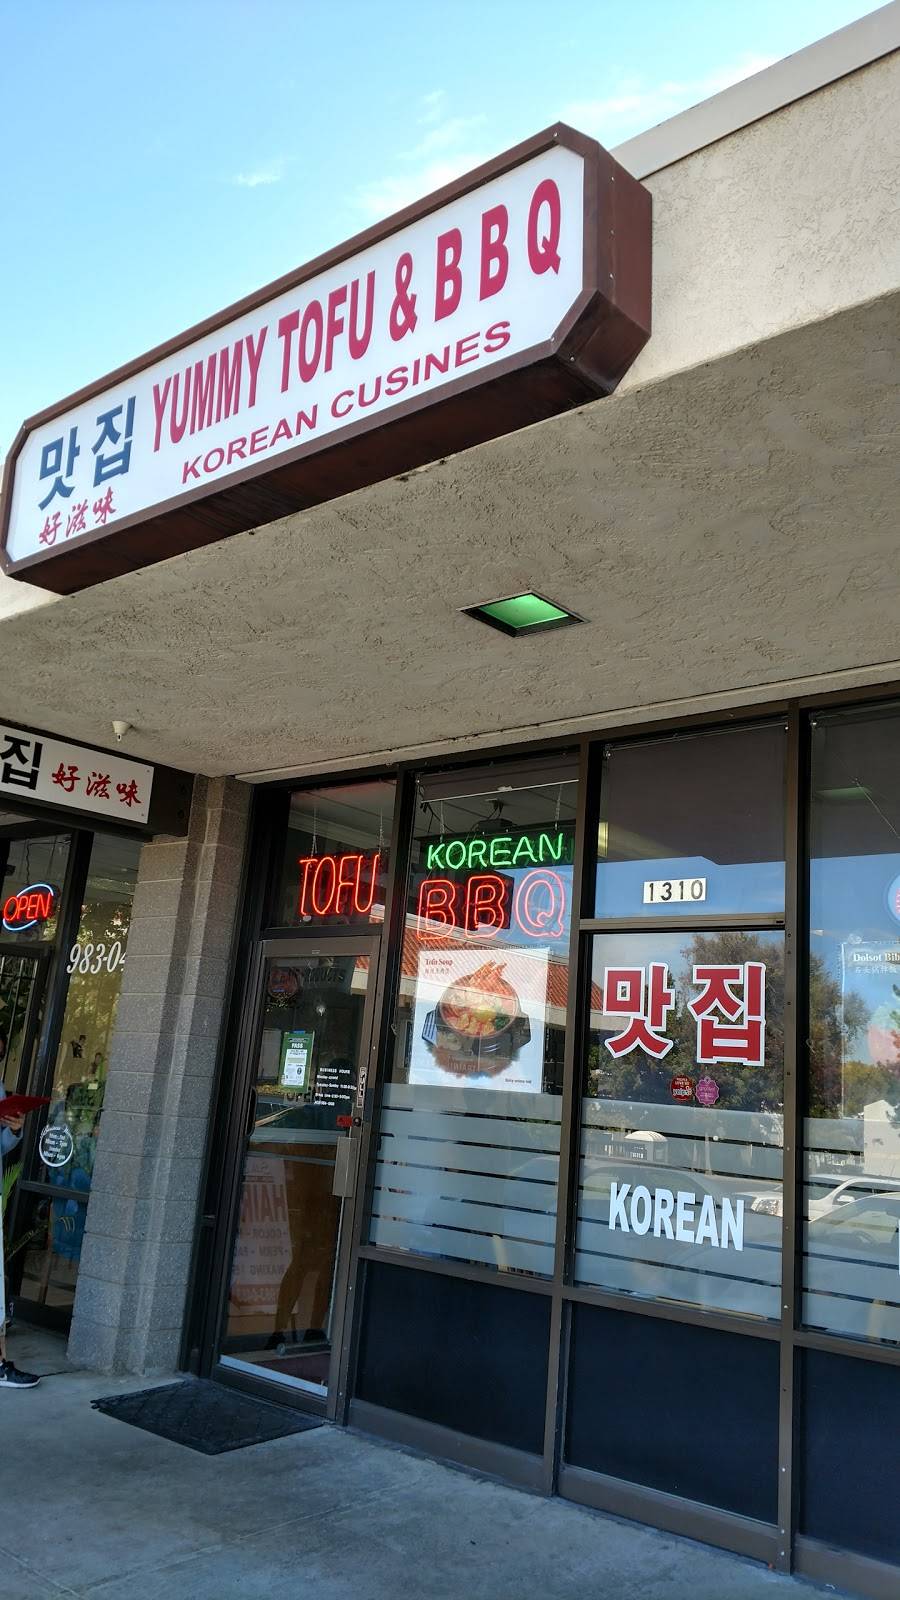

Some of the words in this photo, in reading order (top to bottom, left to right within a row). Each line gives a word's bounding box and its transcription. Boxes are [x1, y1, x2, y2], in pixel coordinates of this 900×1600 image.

[152, 326, 268, 452] YUMMY
[277, 270, 376, 393] TOFU
[389, 252, 418, 342] &
[182, 404, 318, 484] KOREAN
[330, 320, 511, 418] CUSINES
[38, 486, 117, 546] 好滋味
[51, 762, 141, 808] 好滋味
[426, 832, 565, 871] KOREAN
[3, 892, 52, 922] OPEN
[299, 853, 381, 916] TOFU
[415, 868, 566, 941] BBQ
[649, 879, 704, 902] 1310
[608, 1182, 745, 1252] KOREAN
